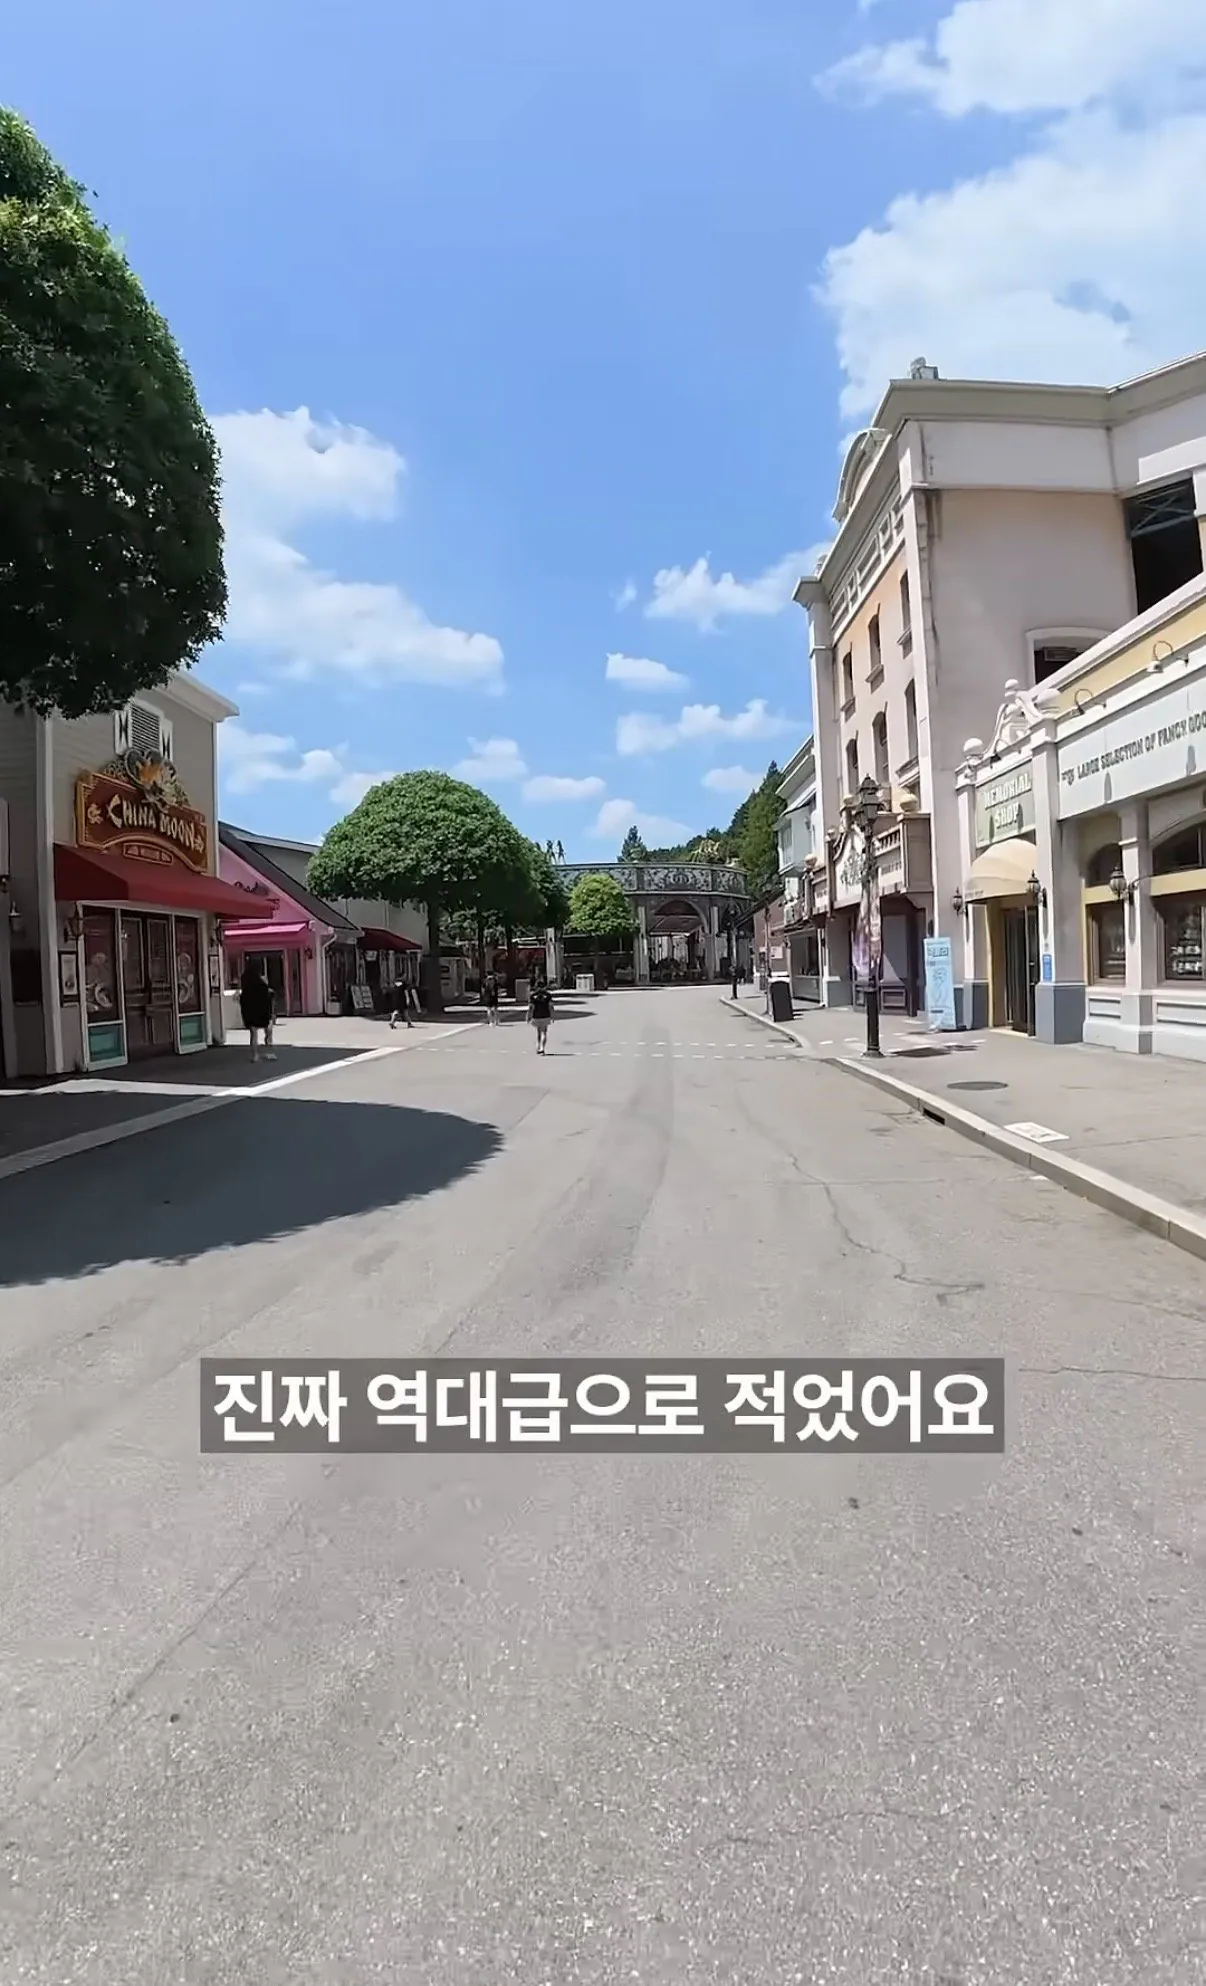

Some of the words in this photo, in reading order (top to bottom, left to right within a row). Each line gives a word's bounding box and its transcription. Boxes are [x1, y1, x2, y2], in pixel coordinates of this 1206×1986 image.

[1101, 738, 1144, 770] SELECTION
[1145, 732, 1156, 752] OF
[1157, 719, 1187, 747] FANCY
[984, 773, 1031, 811] MEMORIAL
[108, 794, 156, 830] CHINA
[159, 813, 195, 852] MOON
[994, 802, 1021, 829] SHOP
